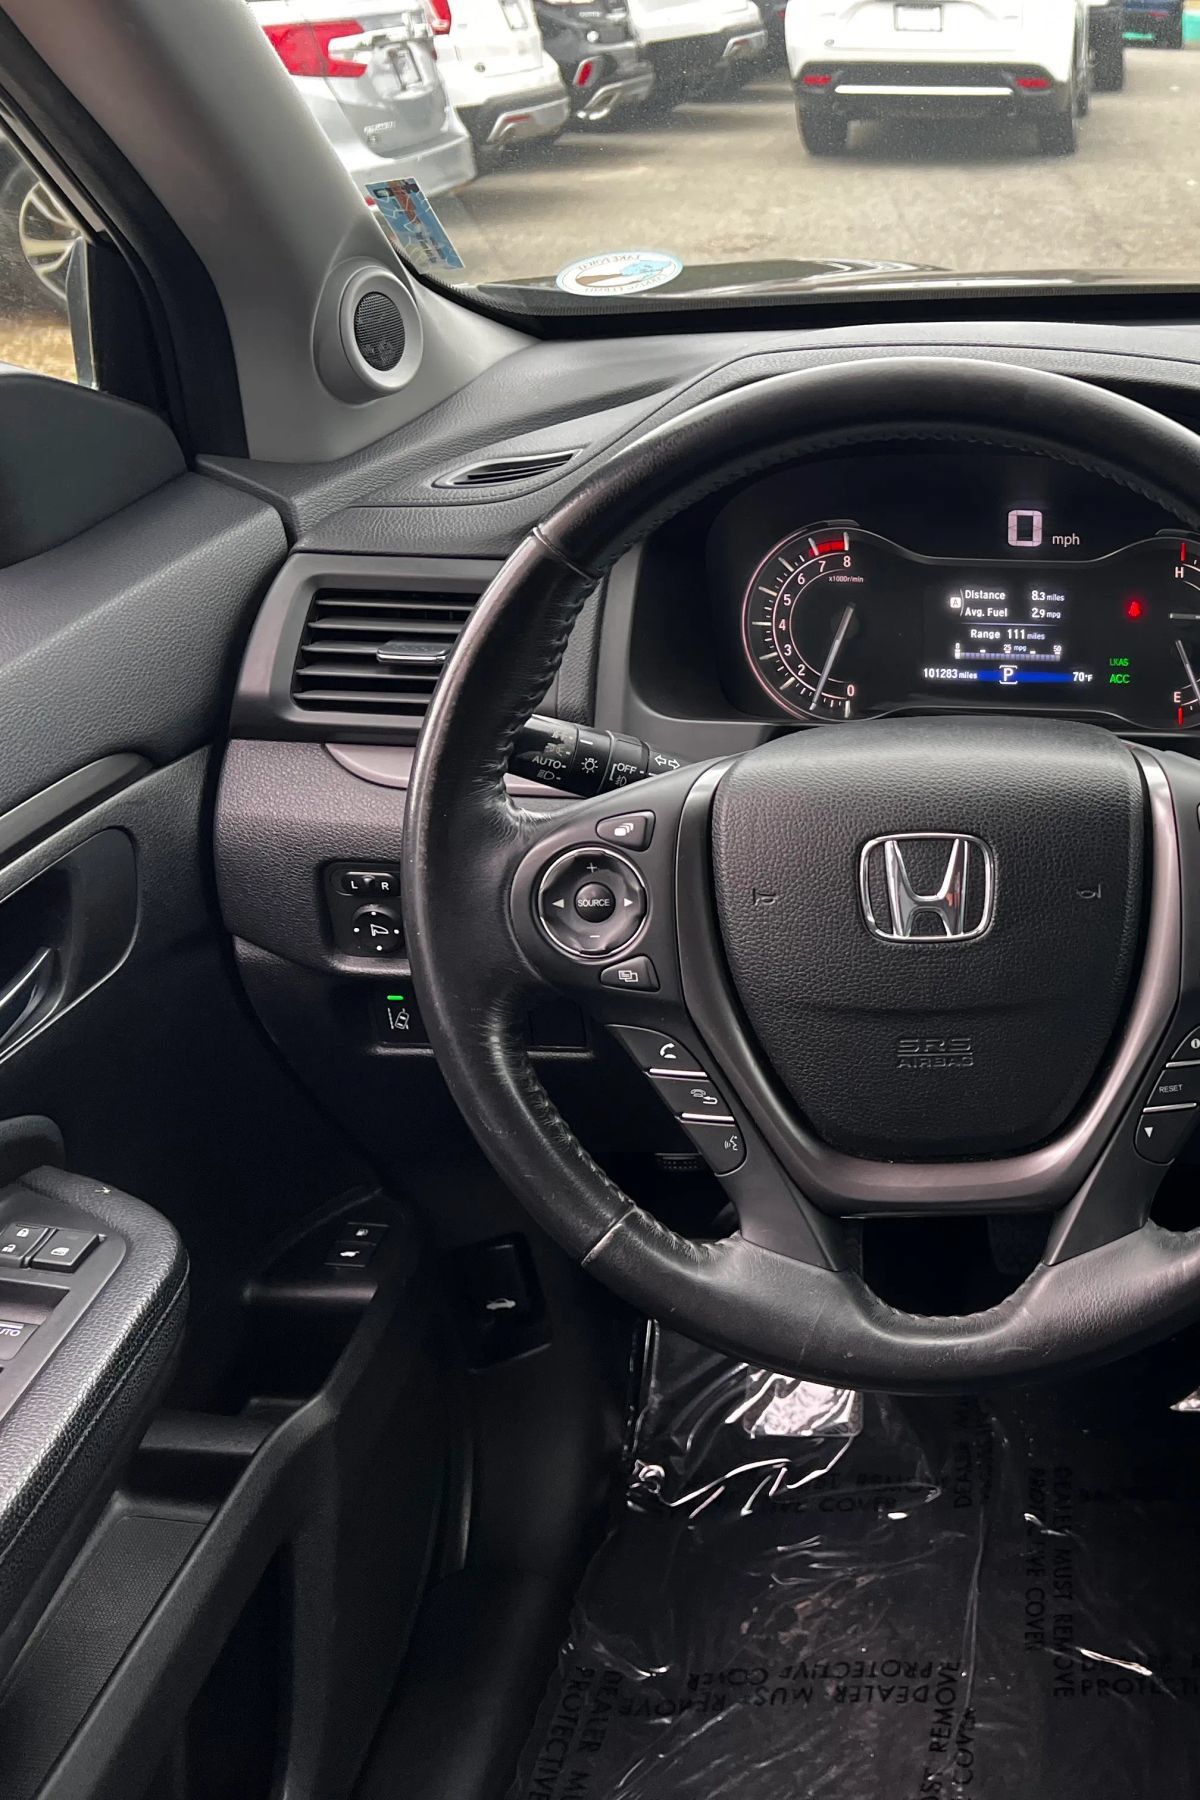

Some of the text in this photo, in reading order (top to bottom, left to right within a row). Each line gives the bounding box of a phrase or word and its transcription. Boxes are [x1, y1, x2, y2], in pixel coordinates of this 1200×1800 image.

[1008, 509, 1080, 547] 0 mph
[818, 560, 827, 573] 7
[843, 555, 852, 568] 8
[1174, 566, 1184, 579] H
[797, 574, 806, 585] 6
[783, 593, 792, 606] 5
[964, 589, 1065, 602] Distance 8.3 miles
[964, 607, 1062, 620] Avg. Fuel 2.9 mpg
[778, 622, 787, 632] 4
[970, 628, 1046, 641] Range 111 miles
[783, 643, 793, 656] 3
[1109, 658, 1130, 667] LKAS
[797, 664, 806, 676] 2
[923, 668, 958, 680] 101283
[958, 671, 978, 680] miles
[1003, 668, 1014, 682] P
[1109, 673, 1131, 684] ACC
[846, 684, 855, 697] 0
[1173, 691, 1182, 703] E
[532, 755, 562, 770] AUTO
[616, 762, 637, 775] OFF
[350, 881, 359, 890] L
[381, 881, 390, 890] R
[577, 897, 610, 907] SOURCE
[898, 1038, 971, 1052] SRS
[1158, 1084, 1183, 1094] RESET
[1053, 1548, 1073, 1601] MUST
[833, 1684, 930, 1705] DEALER
[928, 1661, 960, 1753] REMOVE
